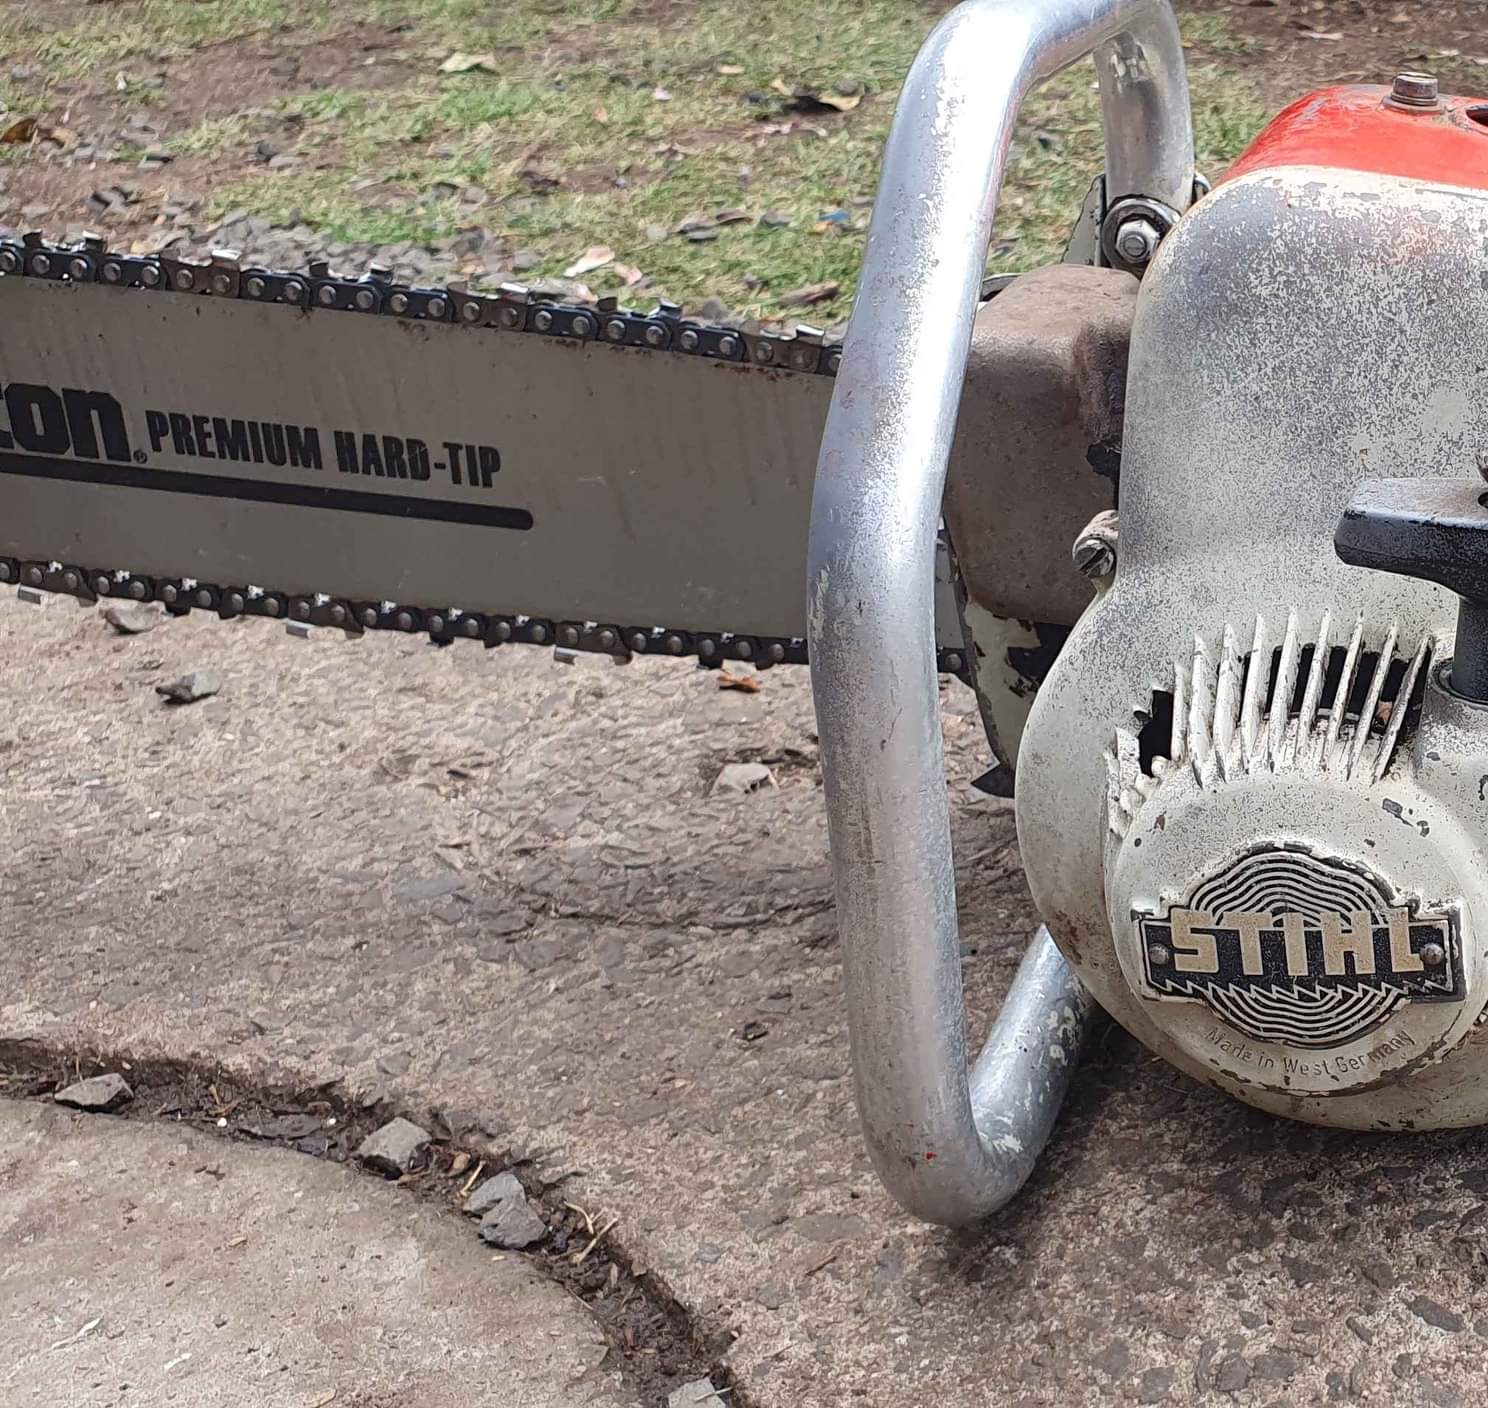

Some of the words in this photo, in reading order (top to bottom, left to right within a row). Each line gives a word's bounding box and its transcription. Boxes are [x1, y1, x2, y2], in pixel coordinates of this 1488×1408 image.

[145, 410, 323, 470] PREMIUM
[334, 431, 501, 488] HARD-TIP
[1170, 908, 1425, 976] STIHL
[1206, 1027, 1253, 1063] Made
[1257, 1052, 1275, 1069] in
[1283, 1057, 1331, 1076] West
[1335, 1030, 1416, 1074] Germany
